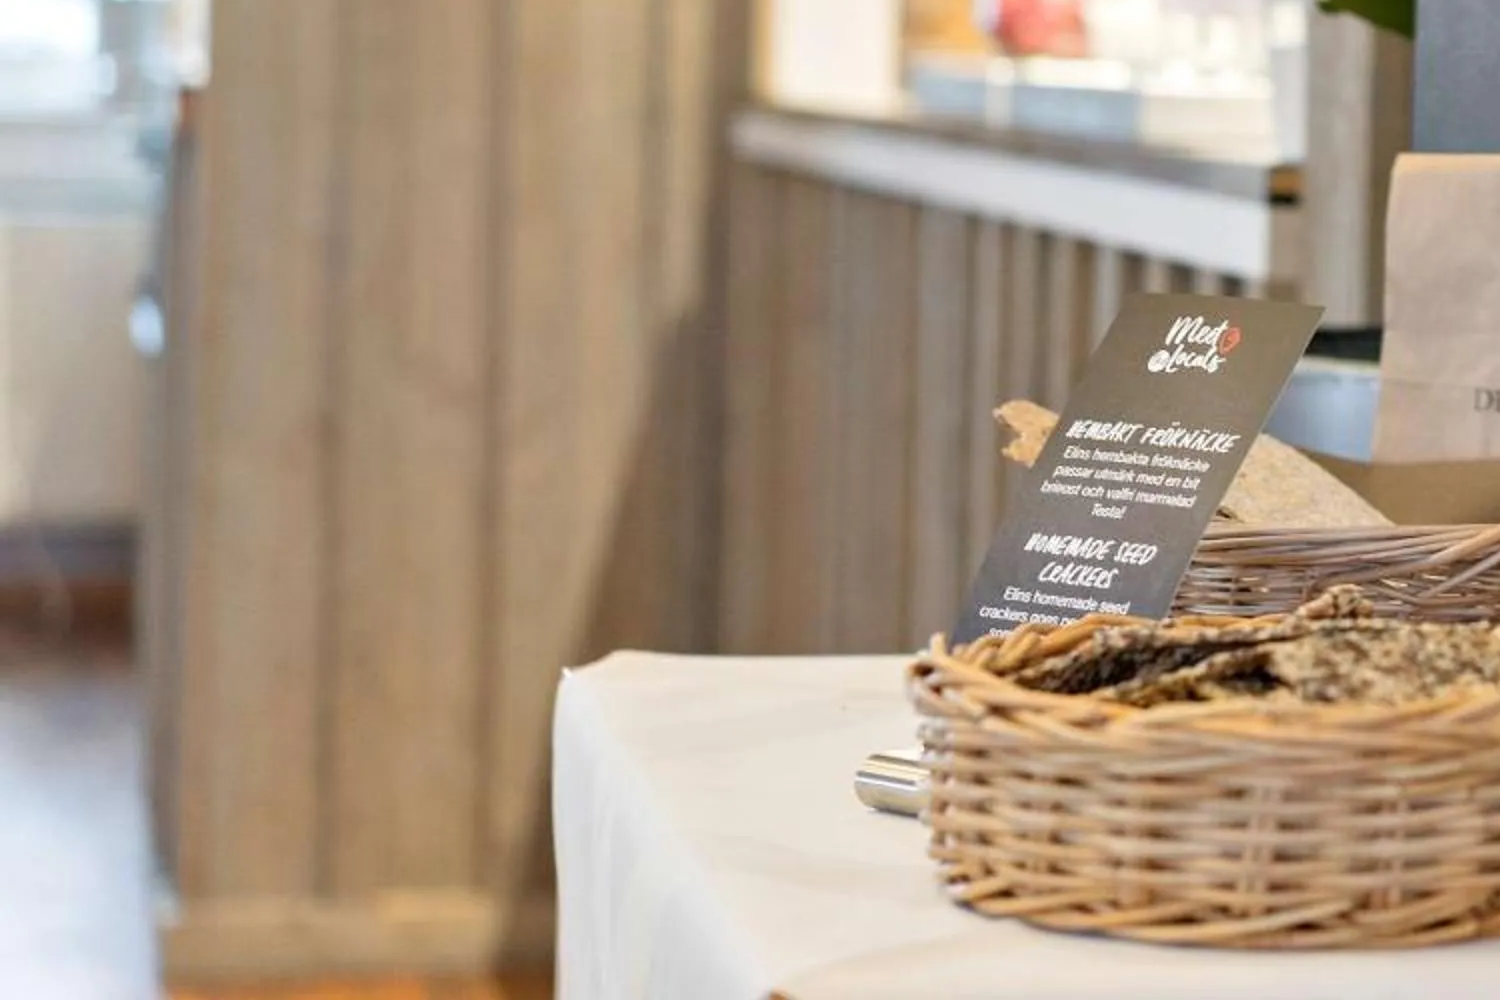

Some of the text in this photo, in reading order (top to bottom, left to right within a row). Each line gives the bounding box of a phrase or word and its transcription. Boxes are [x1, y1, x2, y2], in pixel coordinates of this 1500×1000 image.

[1165, 316, 1229, 346] Meet
[1081, 486, 1104, 499] och
[1135, 473, 1164, 486] med
[1166, 478, 1181, 488] en
[1182, 477, 1201, 490] bit
[1024, 532, 1158, 566] HOMEMADE SEED
[1038, 561, 1119, 589] CRACKERS
[979, 605, 1028, 622] crackers
[1032, 590, 1098, 611] homemade
[1098, 600, 1131, 615] seed
